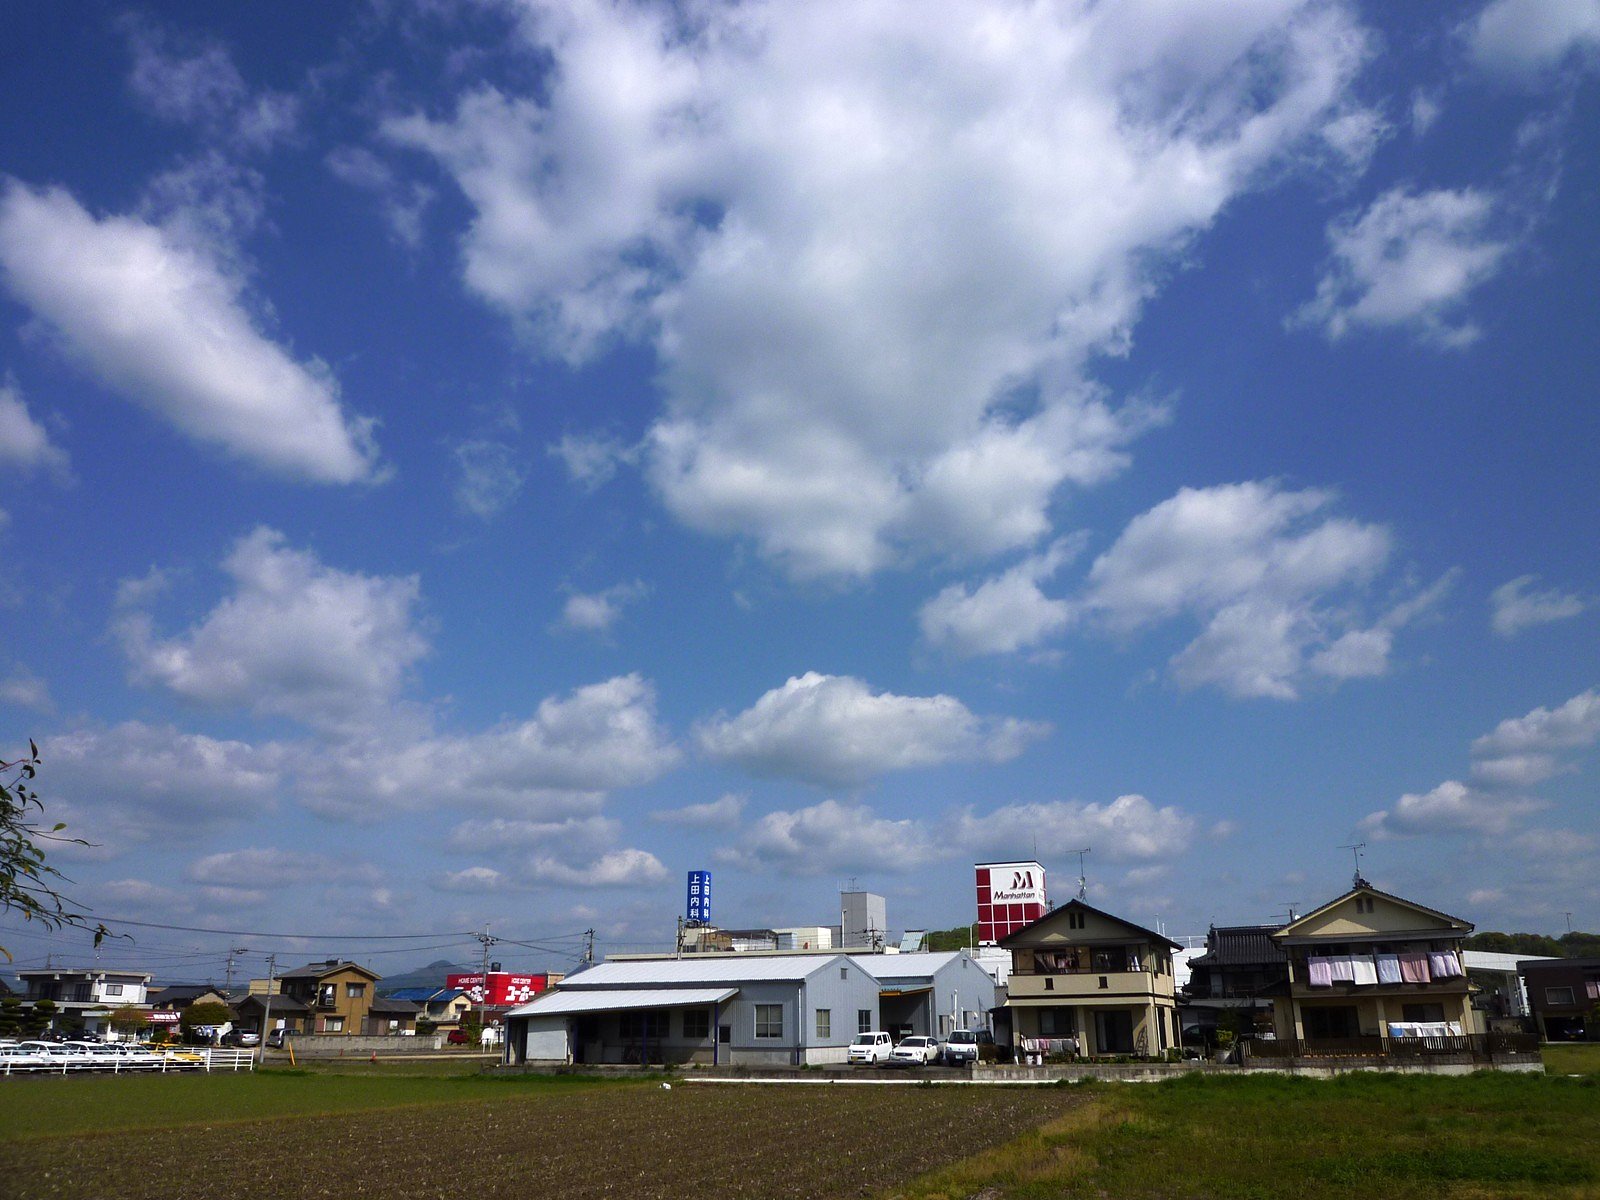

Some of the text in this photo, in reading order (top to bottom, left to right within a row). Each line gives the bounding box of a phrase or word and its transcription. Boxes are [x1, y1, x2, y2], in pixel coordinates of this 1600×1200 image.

[690, 874, 700, 918] 上田内科
[994, 891, 1035, 900] Manhattan
[505, 985, 535, 1001] ユーホー
